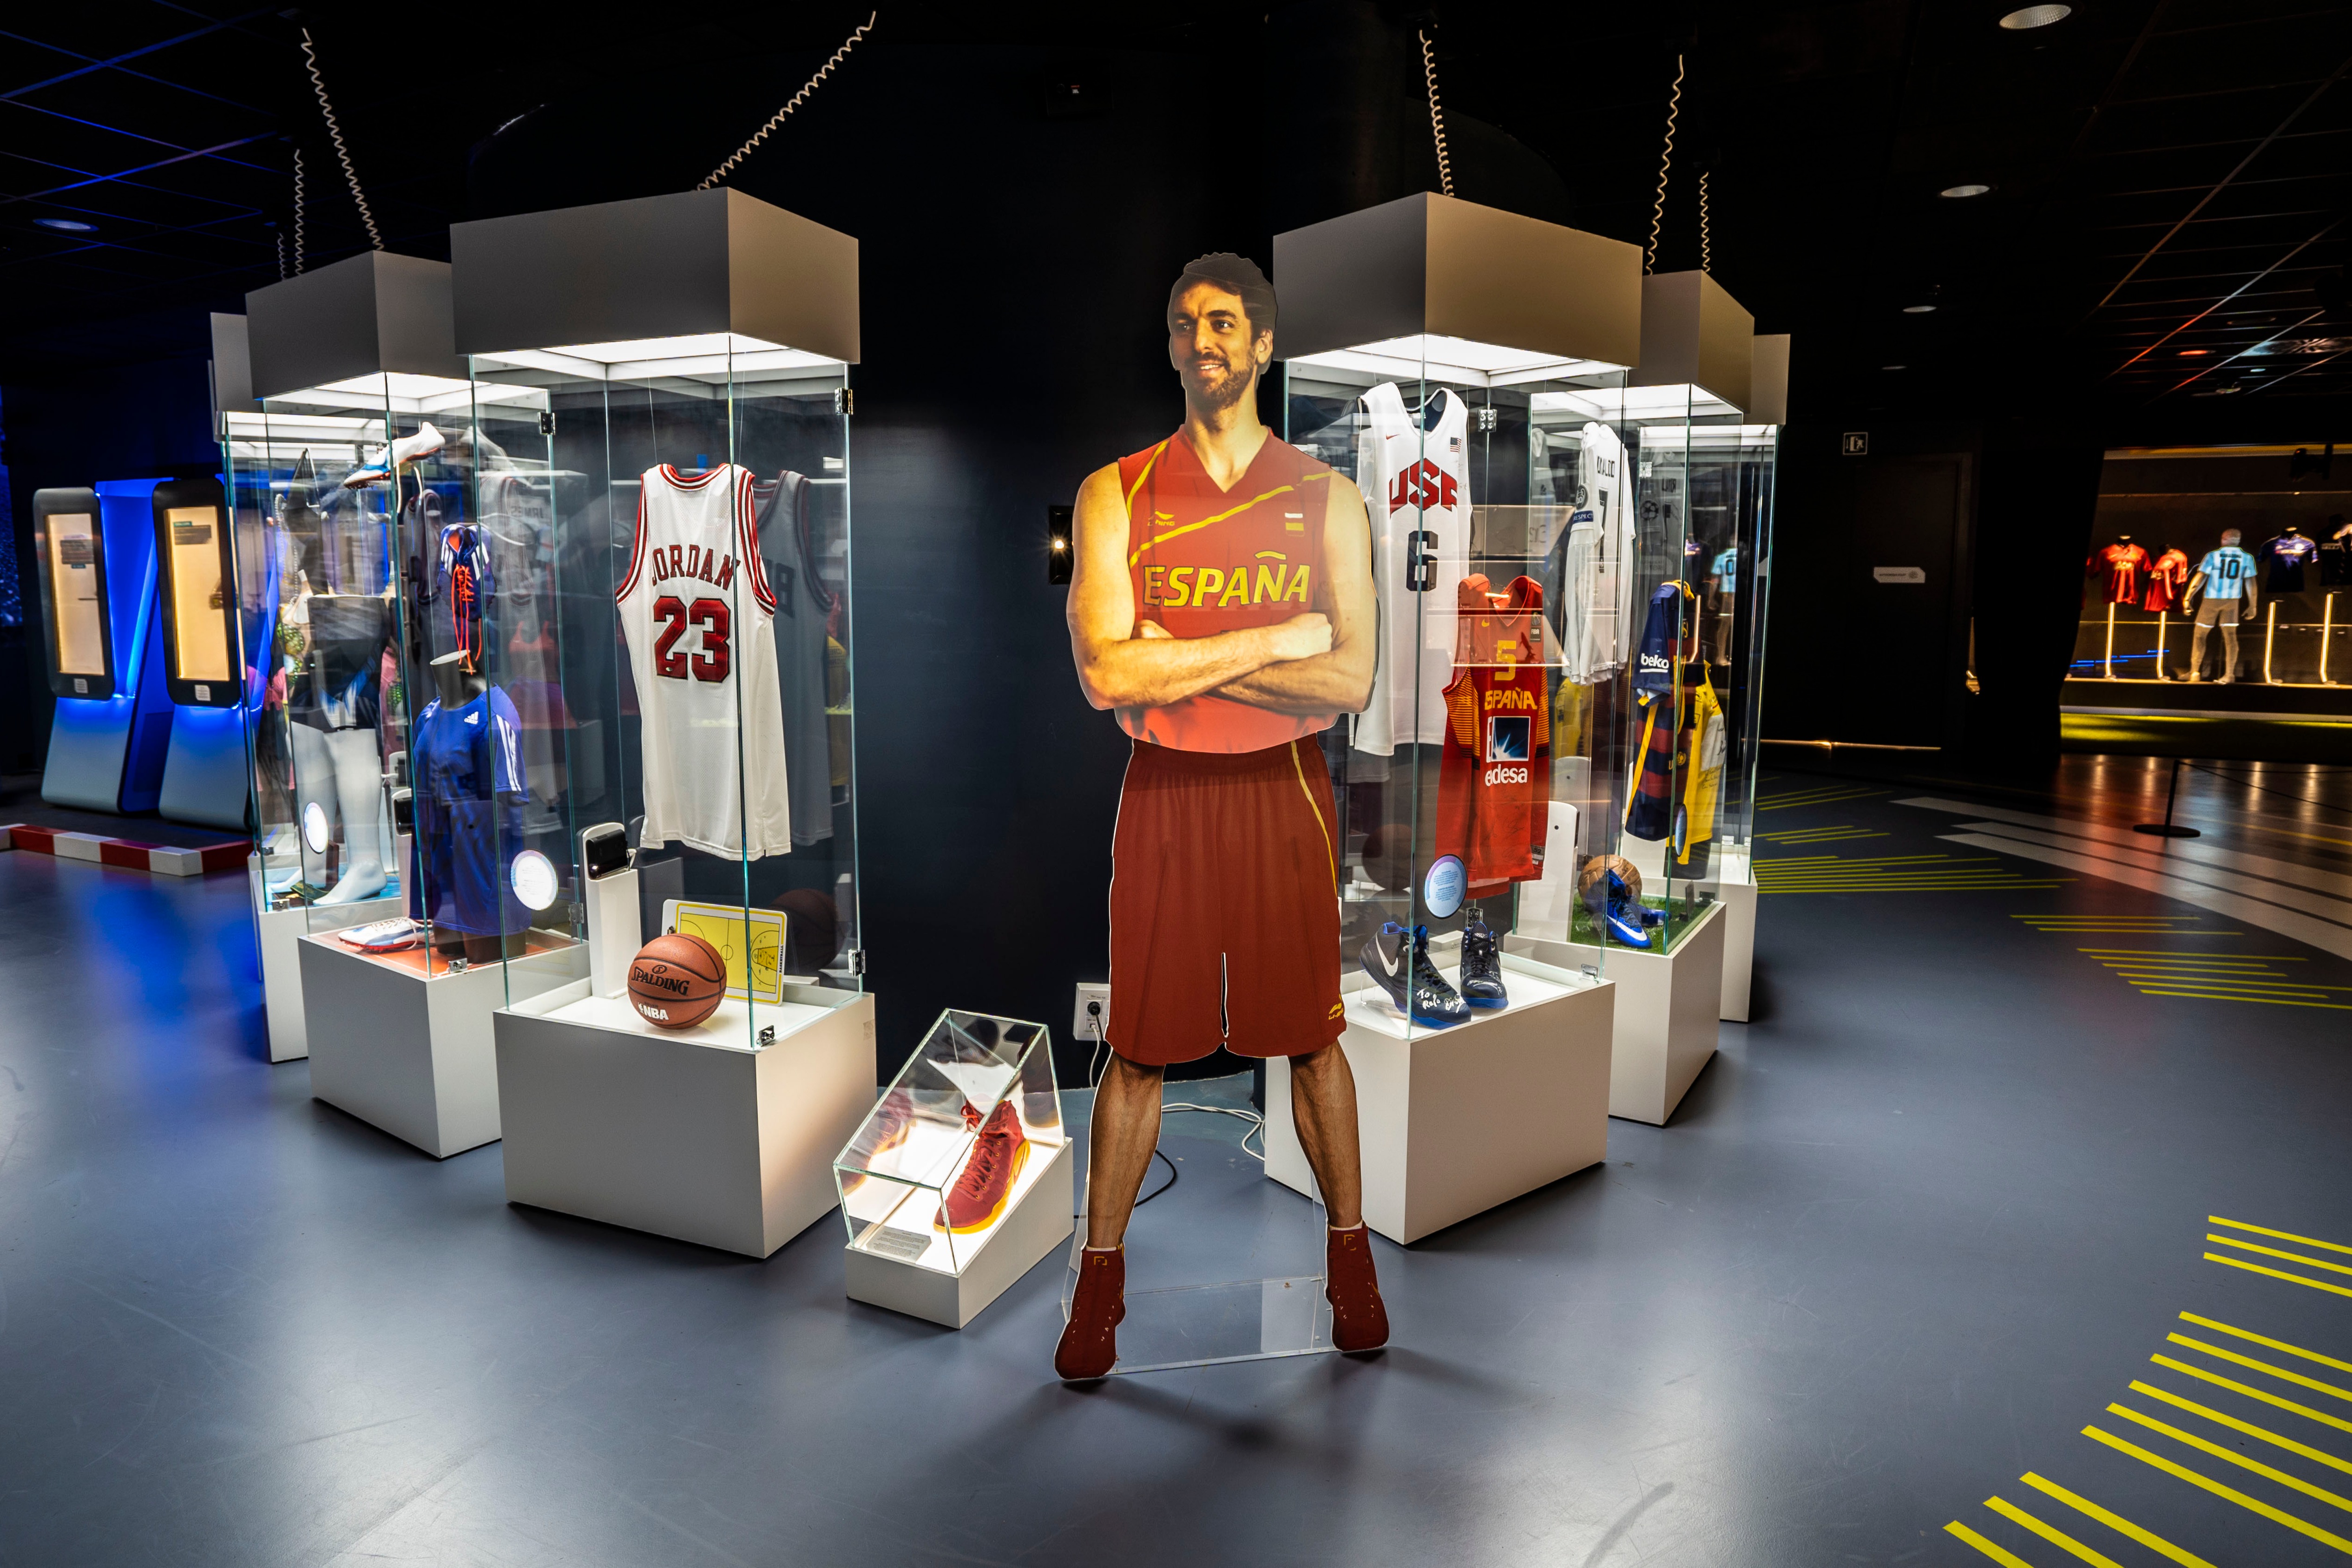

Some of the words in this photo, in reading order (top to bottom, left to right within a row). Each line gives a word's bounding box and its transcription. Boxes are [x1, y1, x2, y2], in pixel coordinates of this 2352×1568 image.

[1406, 530, 1439, 592] 6
[2219, 558, 2240, 580] 10
[1143, 550, 1311, 608] ESPAÑA
[653, 595, 731, 683] 23
[1494, 640, 1517, 681] 5
[1641, 653, 1669, 669] beko
[631, 966, 690, 996] SPALDING
[643, 1004, 669, 1020] NBA
